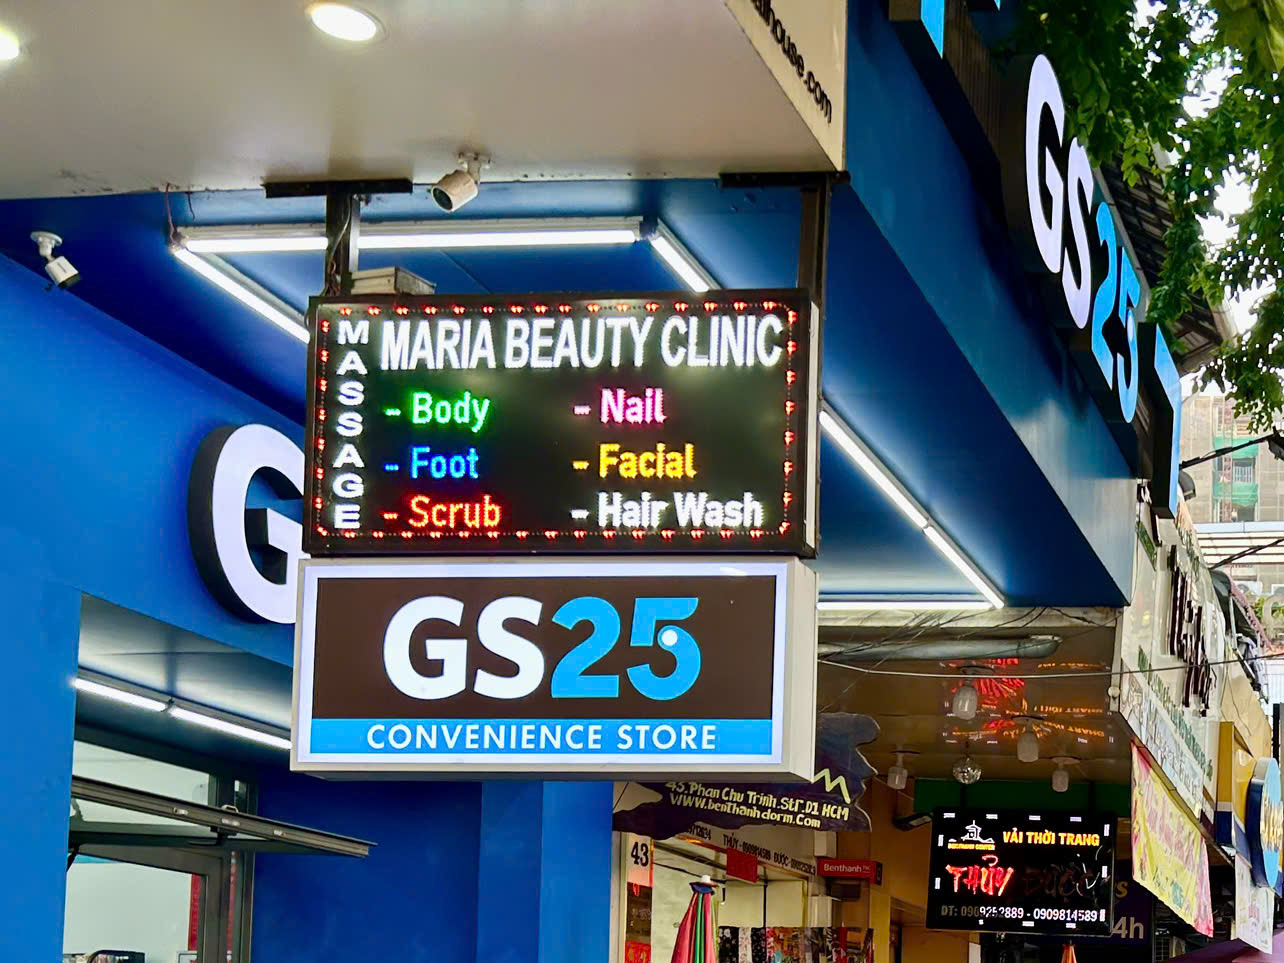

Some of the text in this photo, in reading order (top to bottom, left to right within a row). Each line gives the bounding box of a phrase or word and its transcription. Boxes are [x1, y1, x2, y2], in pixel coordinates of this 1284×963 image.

[1025, 53, 1141, 424] GS25
[380, 315, 784, 371] MARIA BEAUTY CLINIC
[410, 391, 491, 433] Body
[599, 388, 668, 425] Nail
[331, 320, 370, 530] MASSAGE
[409, 446, 480, 479] Foot
[598, 443, 698, 480] Facial
[408, 494, 502, 528] Scrub
[597, 492, 764, 528] Hair Wash
[382, 595, 702, 701] GS25
[366, 723, 717, 751] CONVENIENCE STORE
[721, 786, 744, 803] Chu
[821, 803, 850, 822] HCM
[630, 841, 649, 867] 43
[1003, 827, 1100, 847] VẢI THỜI TRANG
[823, 863, 862, 873] Benthanh
[1033, 907, 1098, 922] 0909814589
